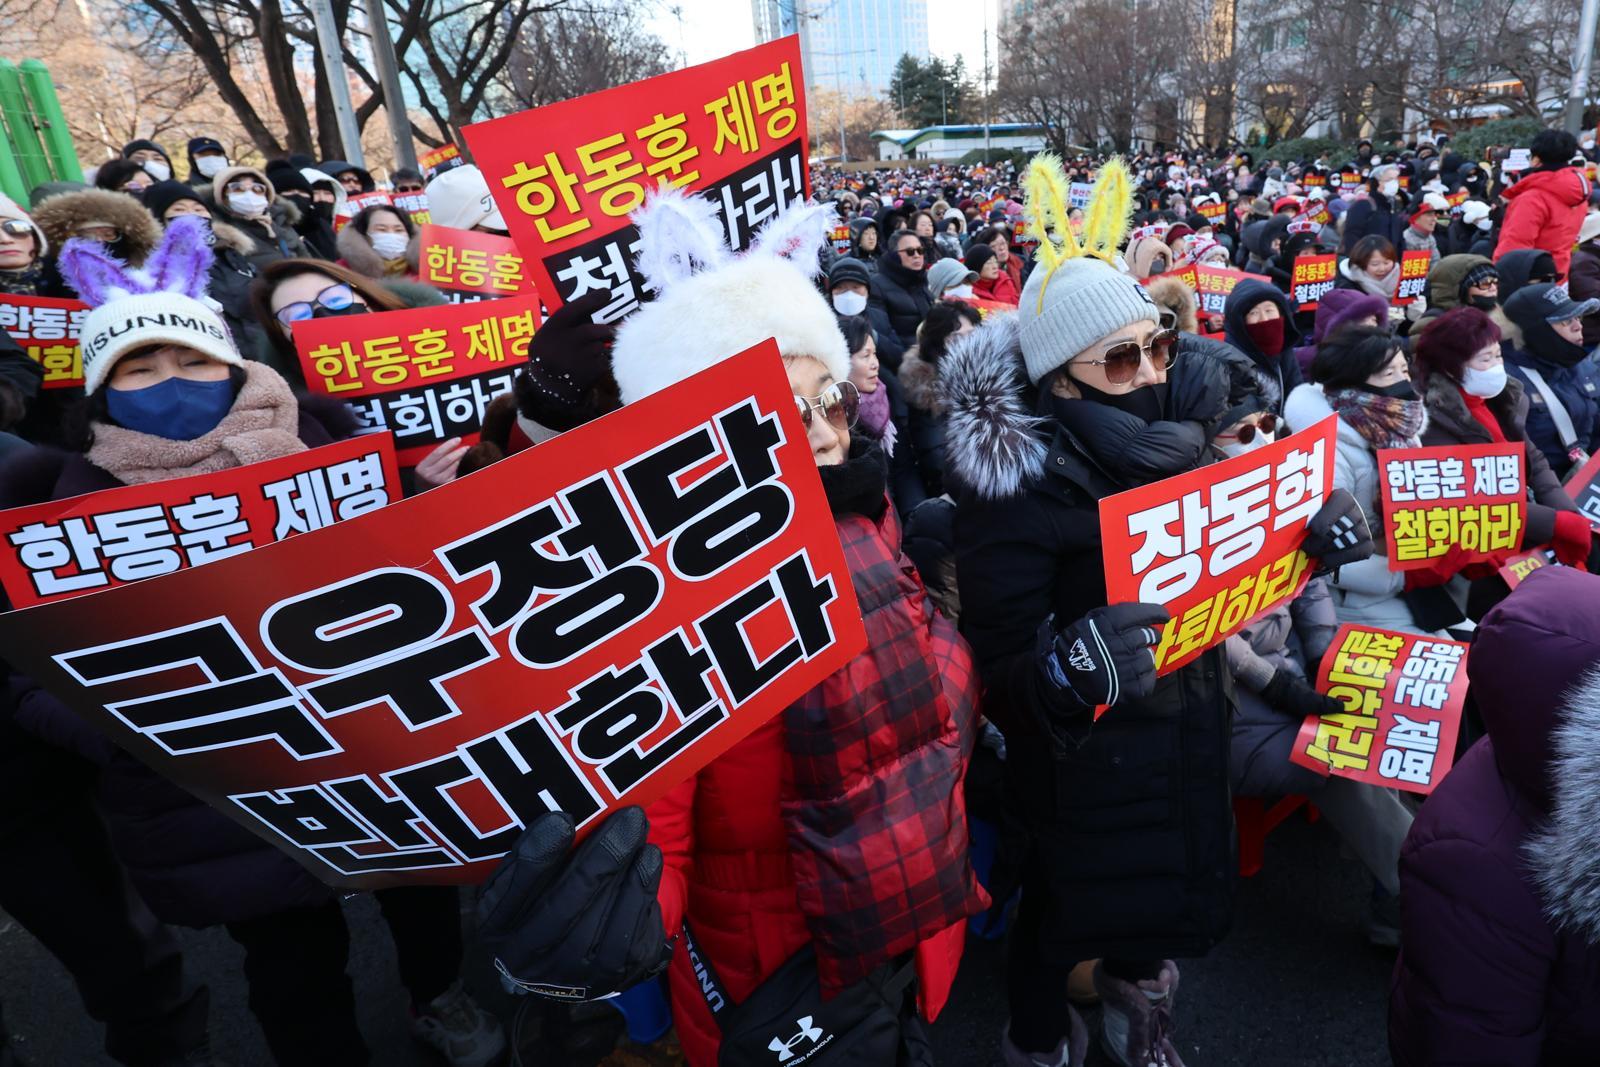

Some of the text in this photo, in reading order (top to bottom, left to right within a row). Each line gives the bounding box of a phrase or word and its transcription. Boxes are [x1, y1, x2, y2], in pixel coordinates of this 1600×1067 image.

[502, 61, 797, 243] 한동훈 제명
[427, 244, 524, 291] 한동훈
[557, 153, 801, 324] 철라!
[1183, 270, 1196, 288] 명
[1295, 262, 1327, 282] 한동훈
[1402, 259, 1427, 277] 한동훈
[27, 344, 84, 381] 회
[309, 309, 537, 394] 한동훈 제명
[1386, 454, 1520, 502] 한동훈 제명
[8, 450, 389, 597] 한동훈 제명
[1127, 437, 1325, 608] 장동혁
[1393, 502, 1522, 561] 철회하라
[52, 394, 796, 762] 극우정당
[228, 546, 838, 875] 반대한다
[1304, 629, 1406, 771] 철회하라
[1378, 639, 1466, 785] 한동훈 제명
[805, 1033, 835, 1059] ARMOUR
